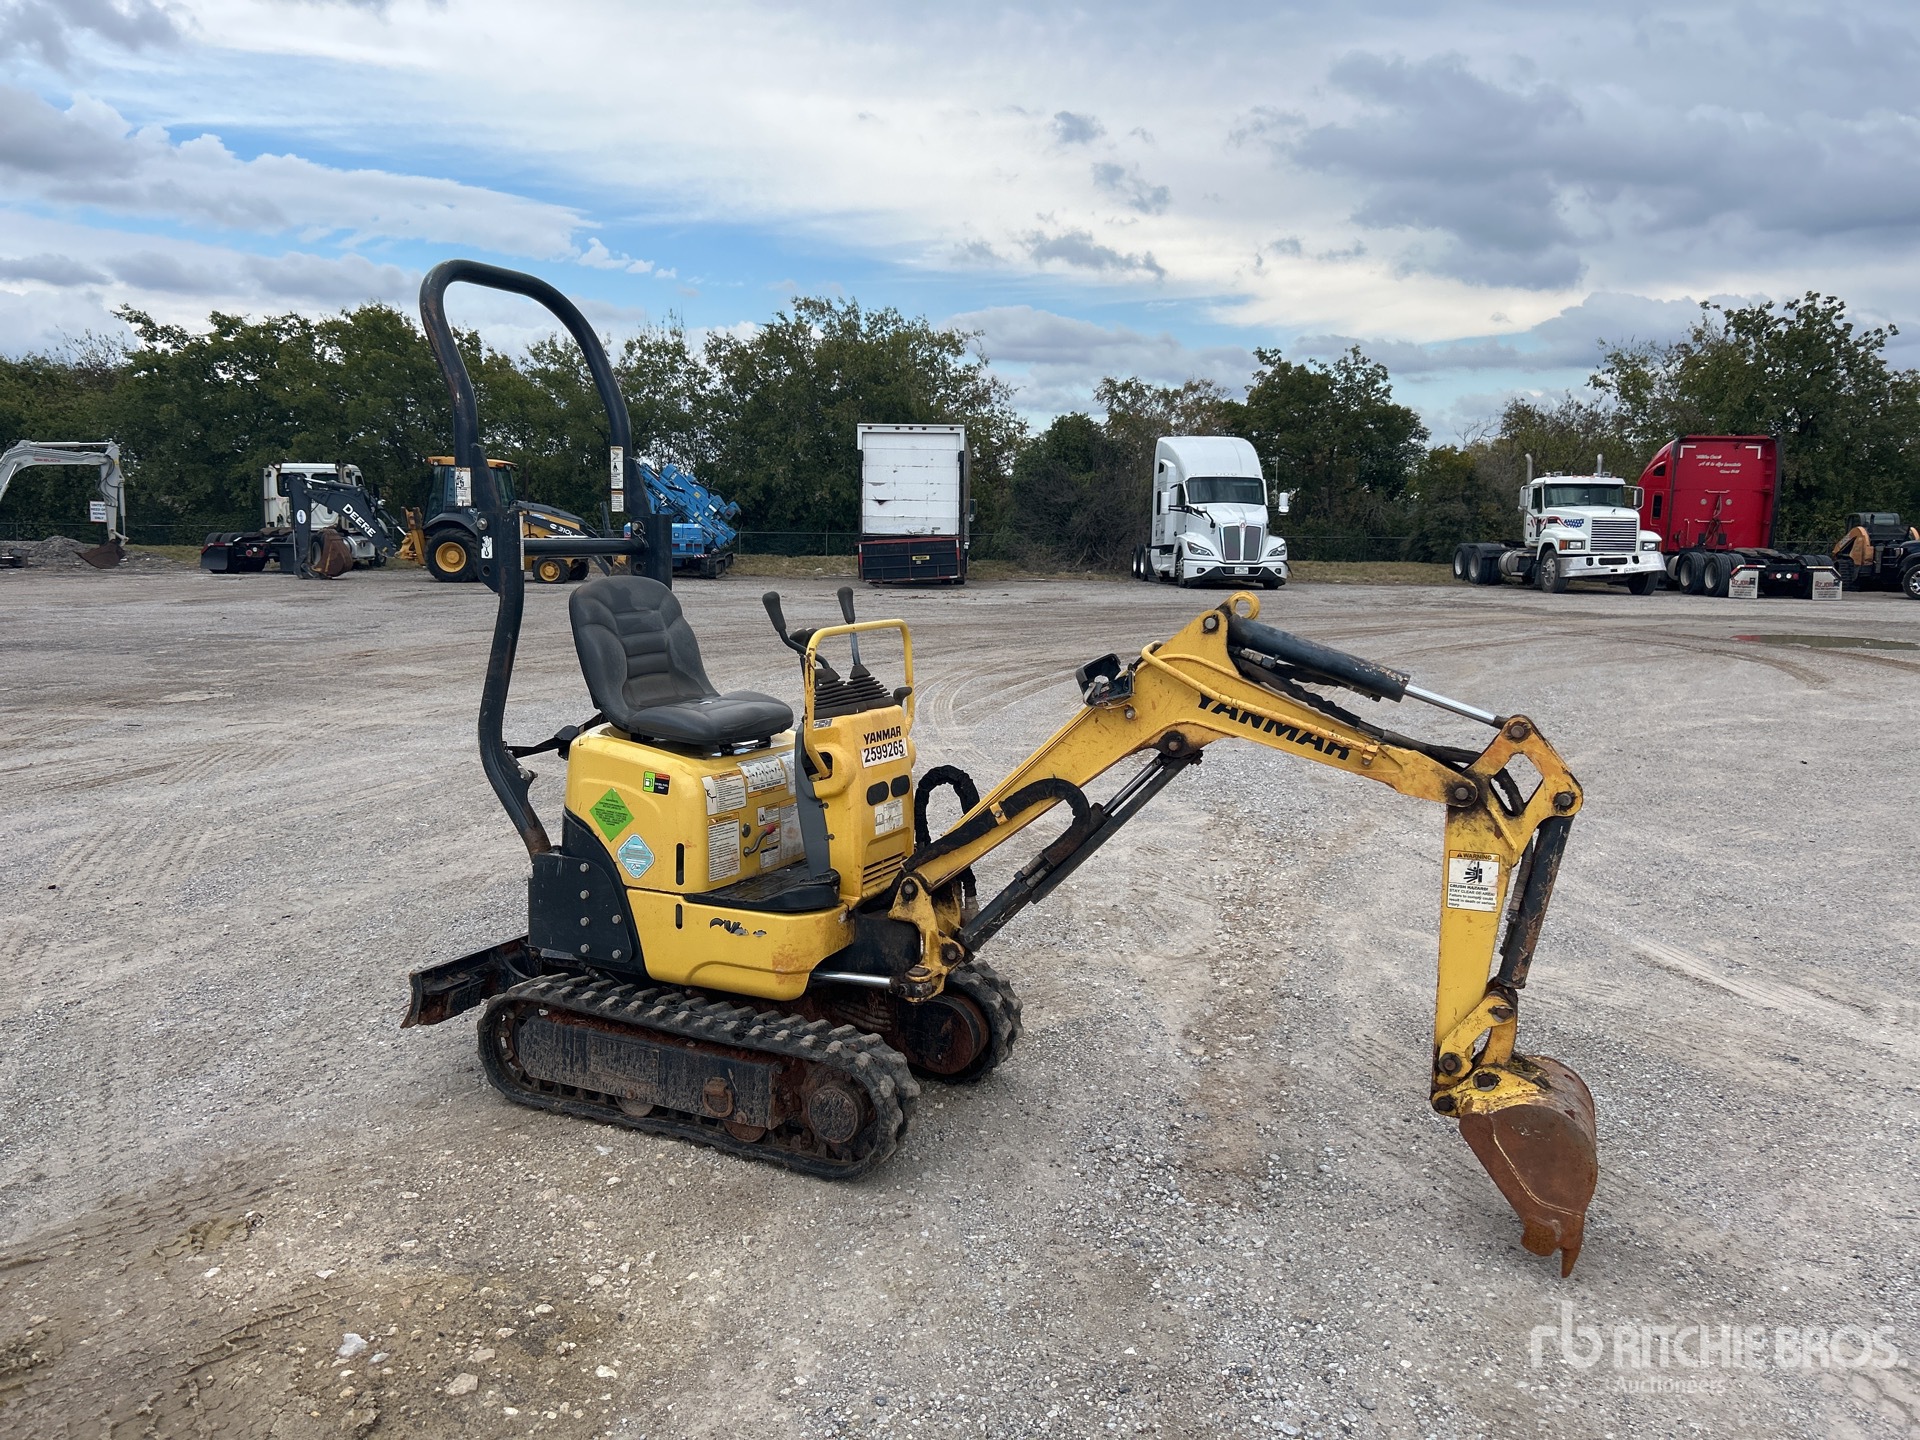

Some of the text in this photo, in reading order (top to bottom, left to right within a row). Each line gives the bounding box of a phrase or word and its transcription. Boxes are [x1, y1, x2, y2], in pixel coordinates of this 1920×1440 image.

[342, 503, 376, 537] DEERE
[863, 725, 902, 745] YANMAR
[1197, 693, 1351, 761] YANMAR
[864, 740, 904, 763] 2599265
